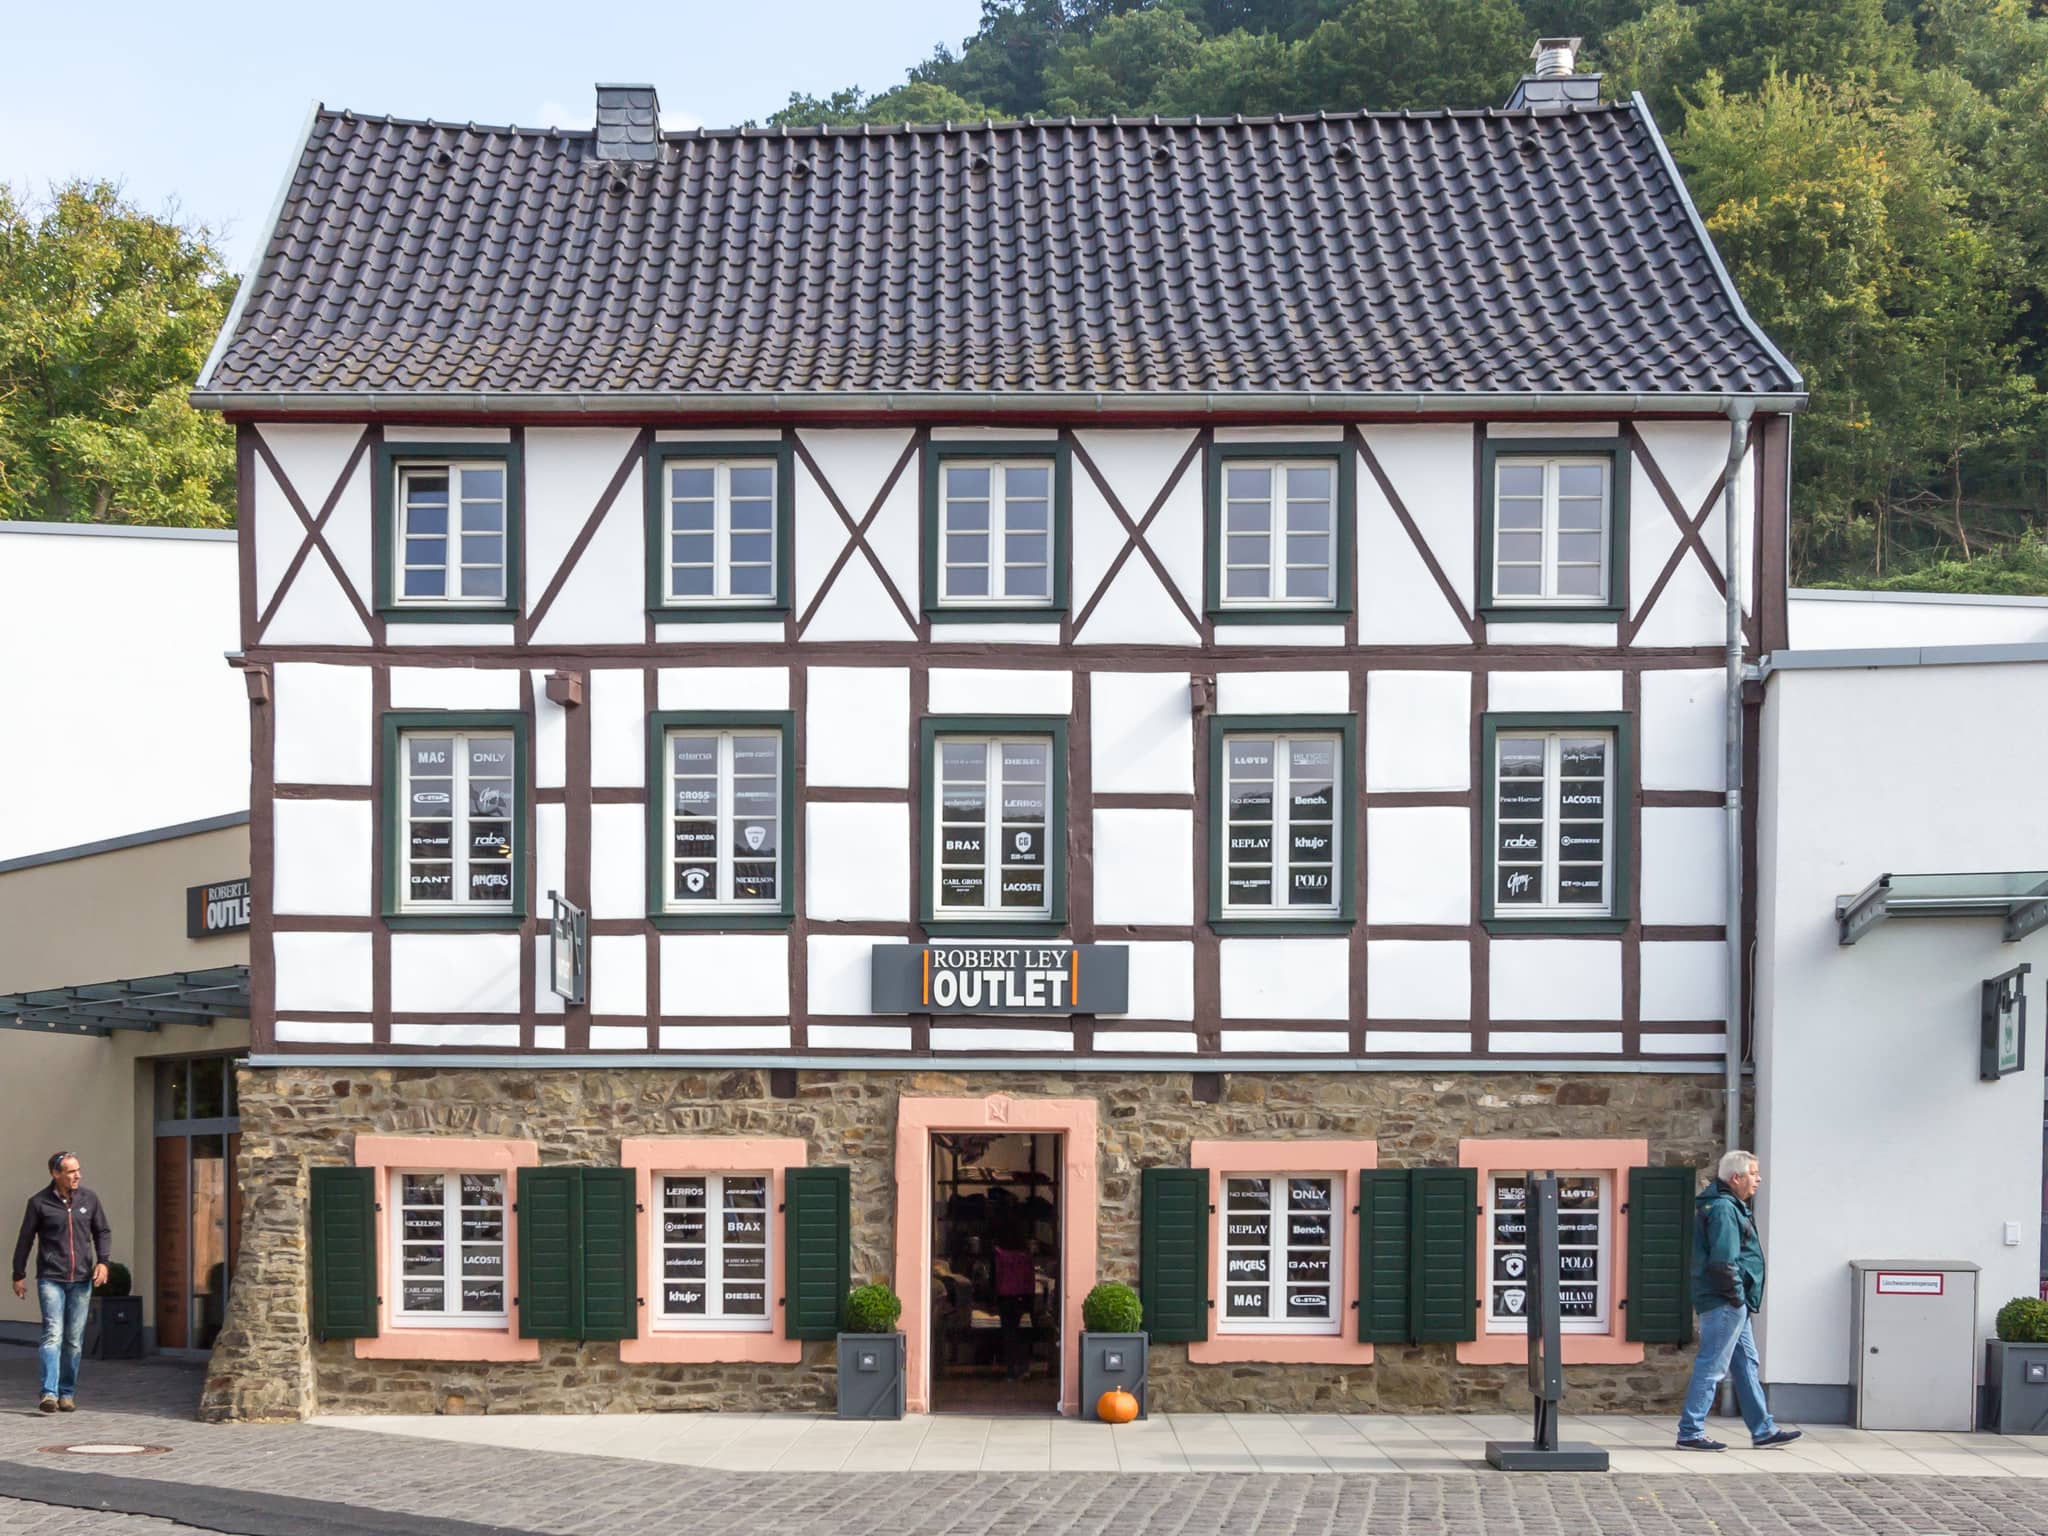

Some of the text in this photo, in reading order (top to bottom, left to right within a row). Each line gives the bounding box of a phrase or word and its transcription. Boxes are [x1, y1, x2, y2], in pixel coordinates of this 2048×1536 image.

[418, 752, 445, 764] MAC
[473, 753, 505, 762] ONLY
[680, 792, 710, 800] CROSS
[1563, 796, 1601, 804] LACOSTE
[475, 833, 505, 845] rabe
[1232, 839, 1271, 848] REPLAY
[1505, 834, 1537, 847] rabe
[947, 841, 980, 850] BRAX
[412, 876, 450, 884] GANT
[473, 875, 509, 887] ANGELS
[1295, 875, 1327, 887] POLO
[209, 883, 243, 901] ROBERT
[1004, 883, 1042, 892] LACOSTE
[208, 897, 250, 929] OUTLE
[934, 950, 1067, 968] ROBERT LEY
[934, 970, 1068, 1007] OUTLET
[1293, 1191, 1326, 1199] ONLY
[728, 1223, 761, 1231] BRAX
[1230, 1225, 1268, 1234] REPLAY
[1293, 1226, 1325, 1234] Bench.
[464, 1256, 501, 1264] LACOSTE
[1561, 1257, 1593, 1268] POLO
[1230, 1260, 1266, 1272] ANGELS
[1234, 1295, 1262, 1306] MAC
